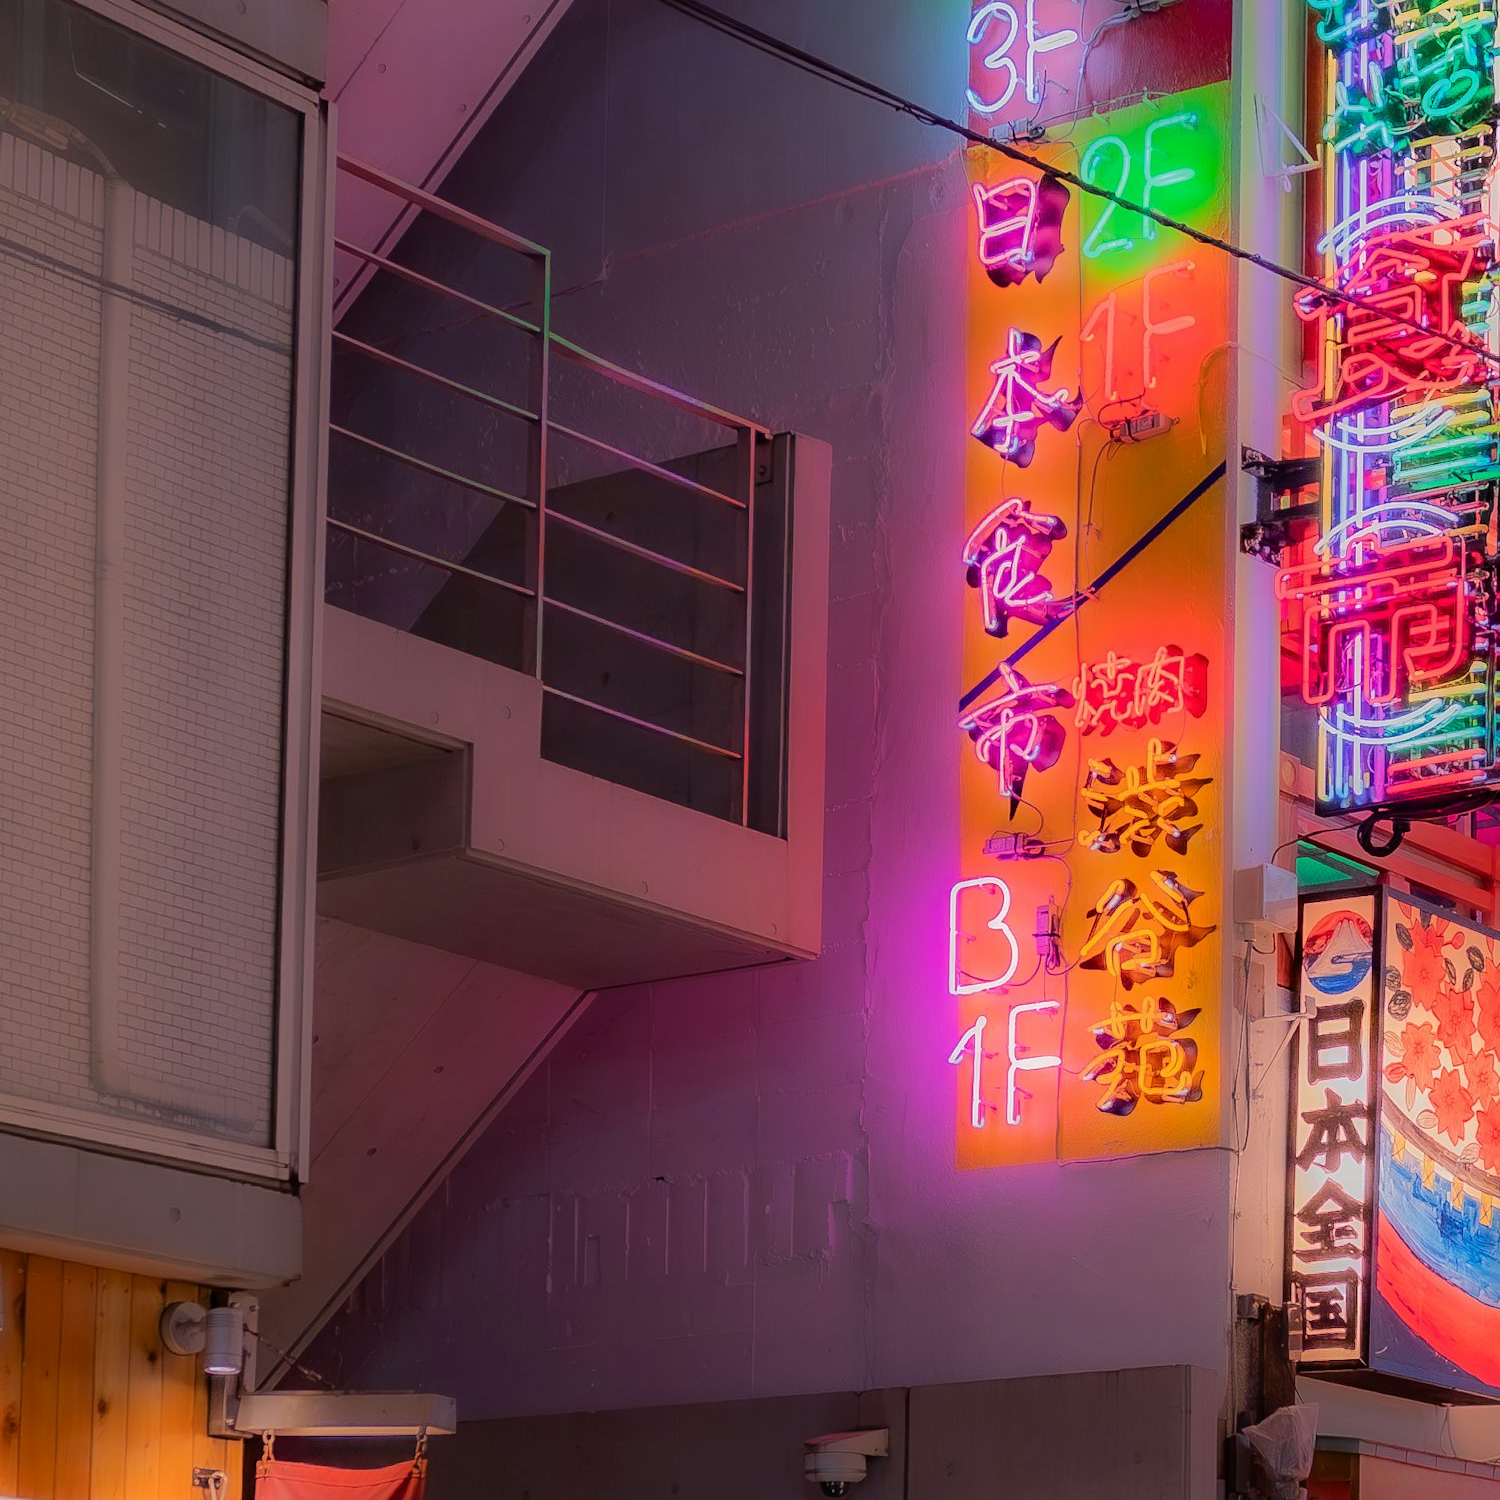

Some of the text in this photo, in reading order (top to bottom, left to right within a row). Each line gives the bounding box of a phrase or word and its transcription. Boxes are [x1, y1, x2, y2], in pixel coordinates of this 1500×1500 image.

[1081, 112, 1198, 258] 2F
[1081, 259, 1195, 398] 1F
[960, 175, 1082, 818] 日本食市
[1074, 645, 1207, 736] 焼肉
[1077, 740, 1213, 1116] 渋谷苑
[948, 1000, 1062, 1128] 1F
[1297, 997, 1368, 1351] 日本全国
